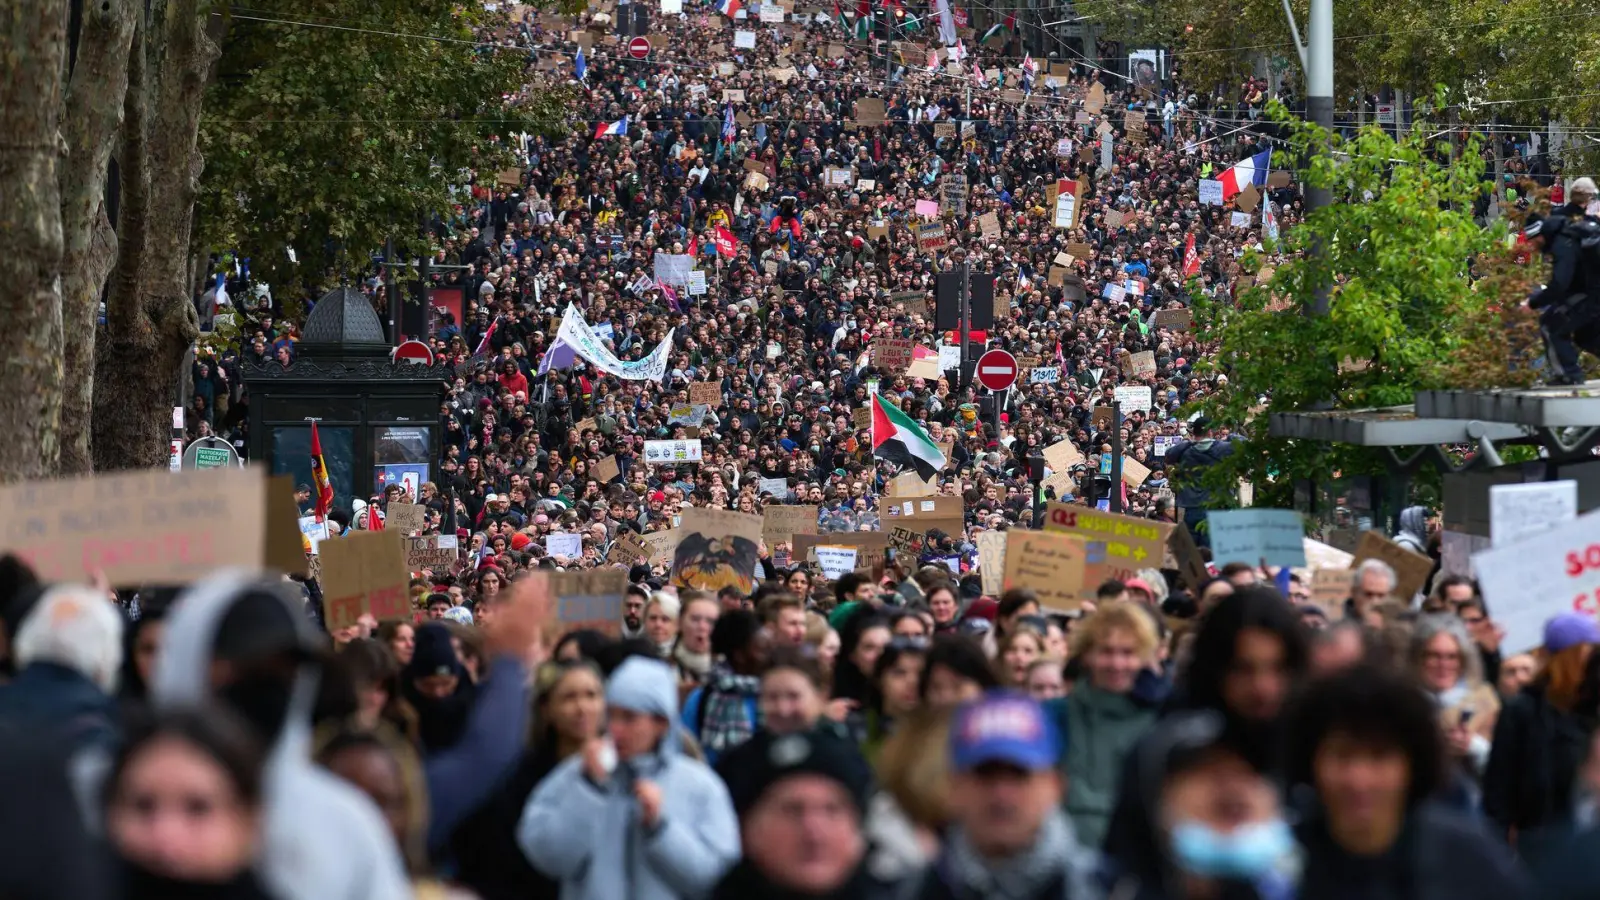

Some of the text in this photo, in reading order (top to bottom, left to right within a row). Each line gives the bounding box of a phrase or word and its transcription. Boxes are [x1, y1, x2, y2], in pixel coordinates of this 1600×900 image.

[880, 357, 903, 365] MONDE
[1034, 369, 1057, 380] 1312
[1052, 508, 1078, 527] CRS
[408, 556, 453, 566] CORRUPTION
